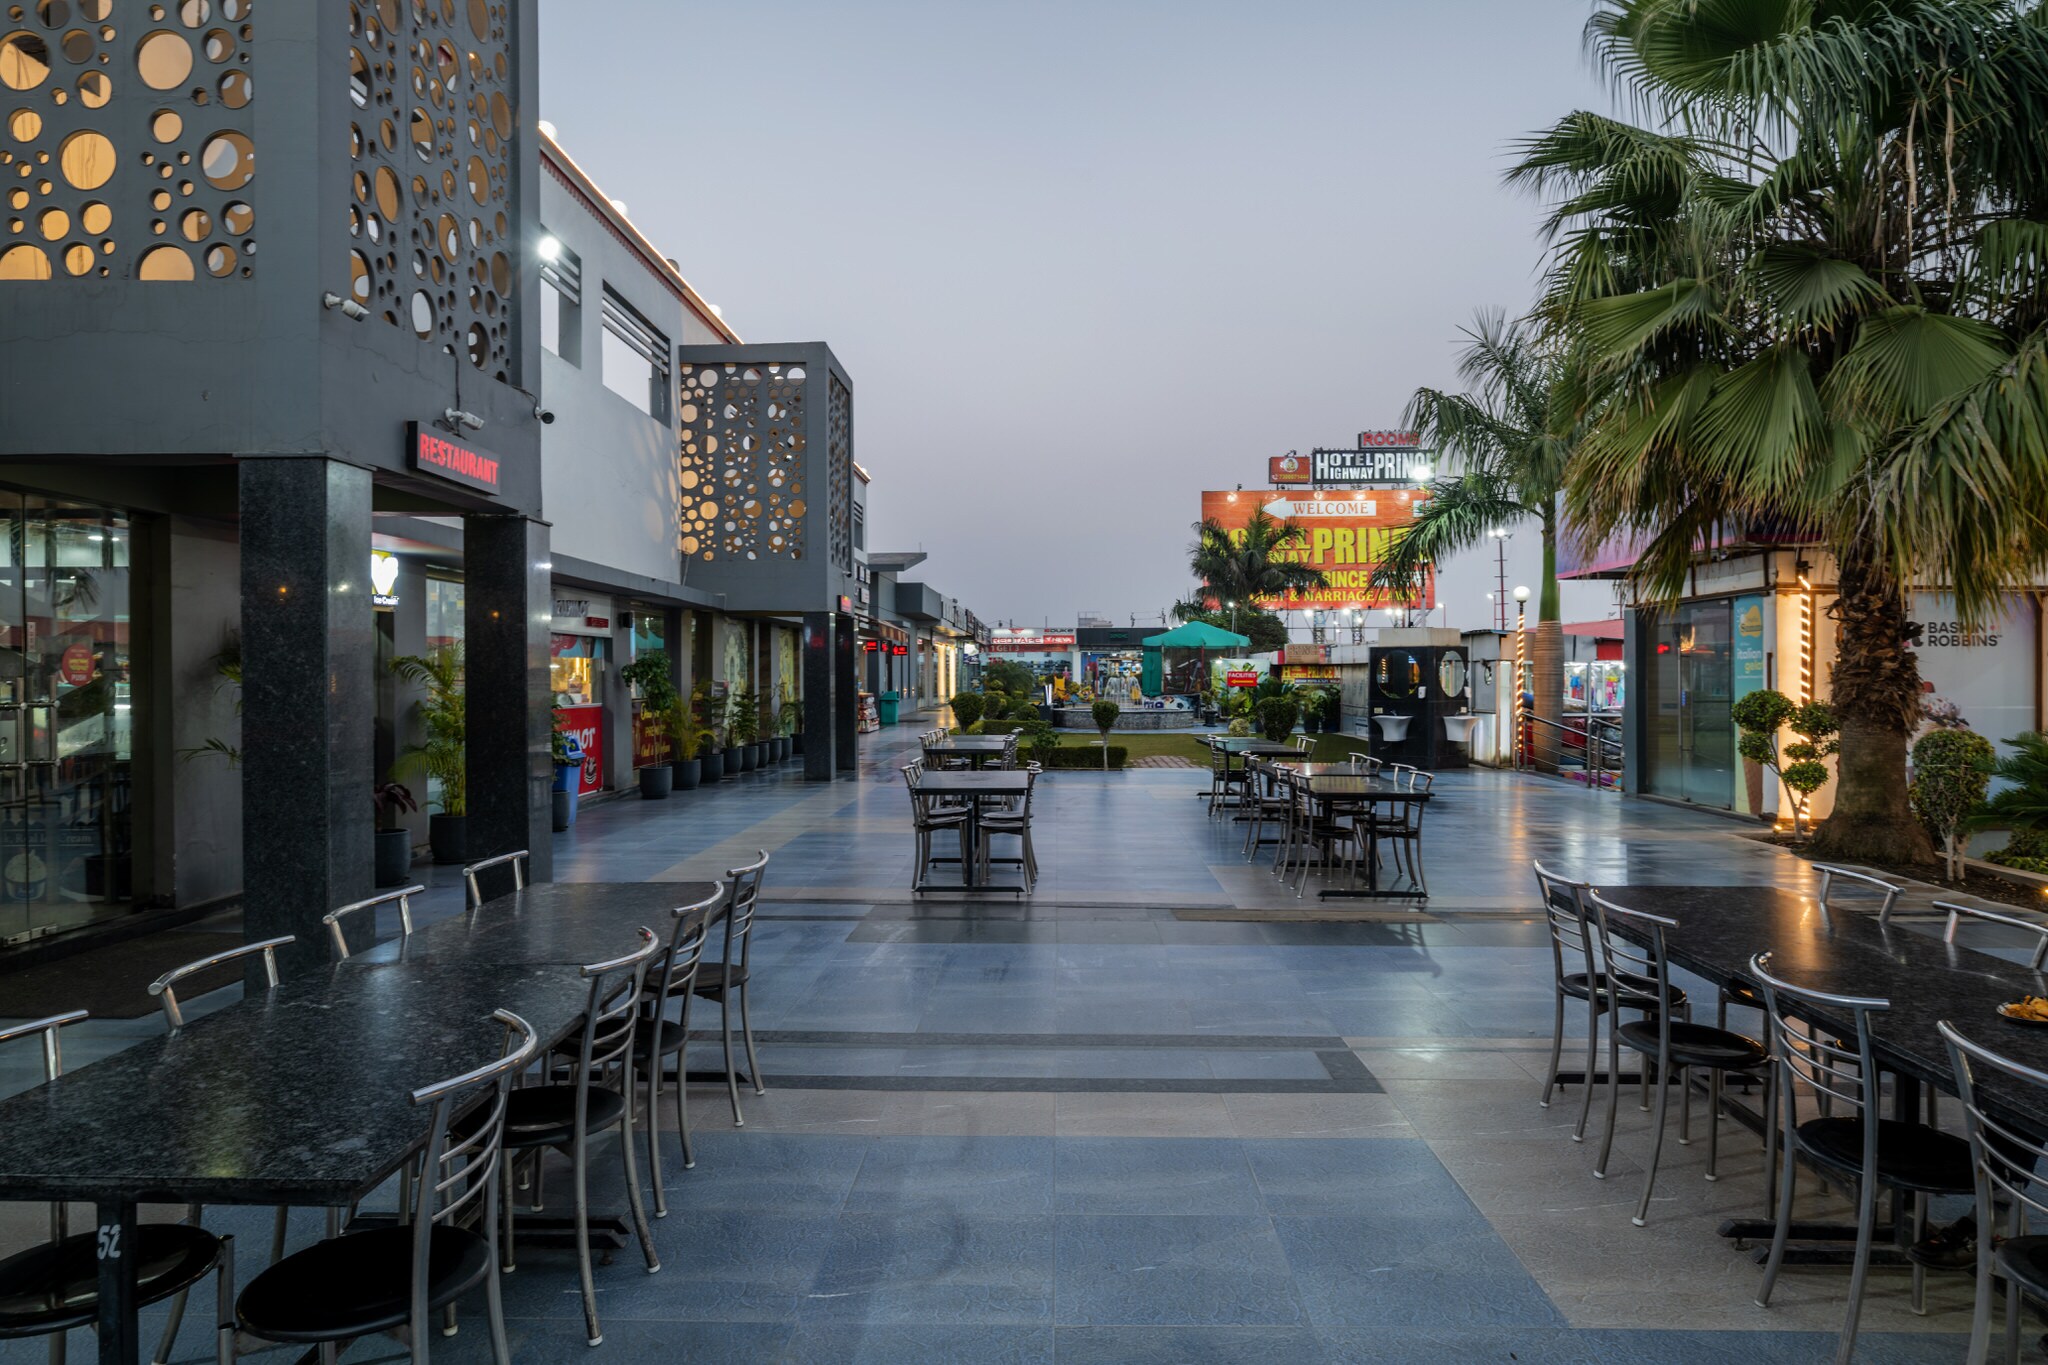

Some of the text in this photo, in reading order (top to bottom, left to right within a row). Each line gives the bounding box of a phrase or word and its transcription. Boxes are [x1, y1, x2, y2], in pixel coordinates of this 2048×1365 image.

[1363, 432, 1421, 446] ROOMS
[420, 433, 499, 485] RESTAURANT
[1293, 502, 1369, 515] WELCOME
[1289, 591, 1299, 602] &
[1304, 591, 1375, 602] MARRIAGE
[97, 1224, 121, 1260] 52
